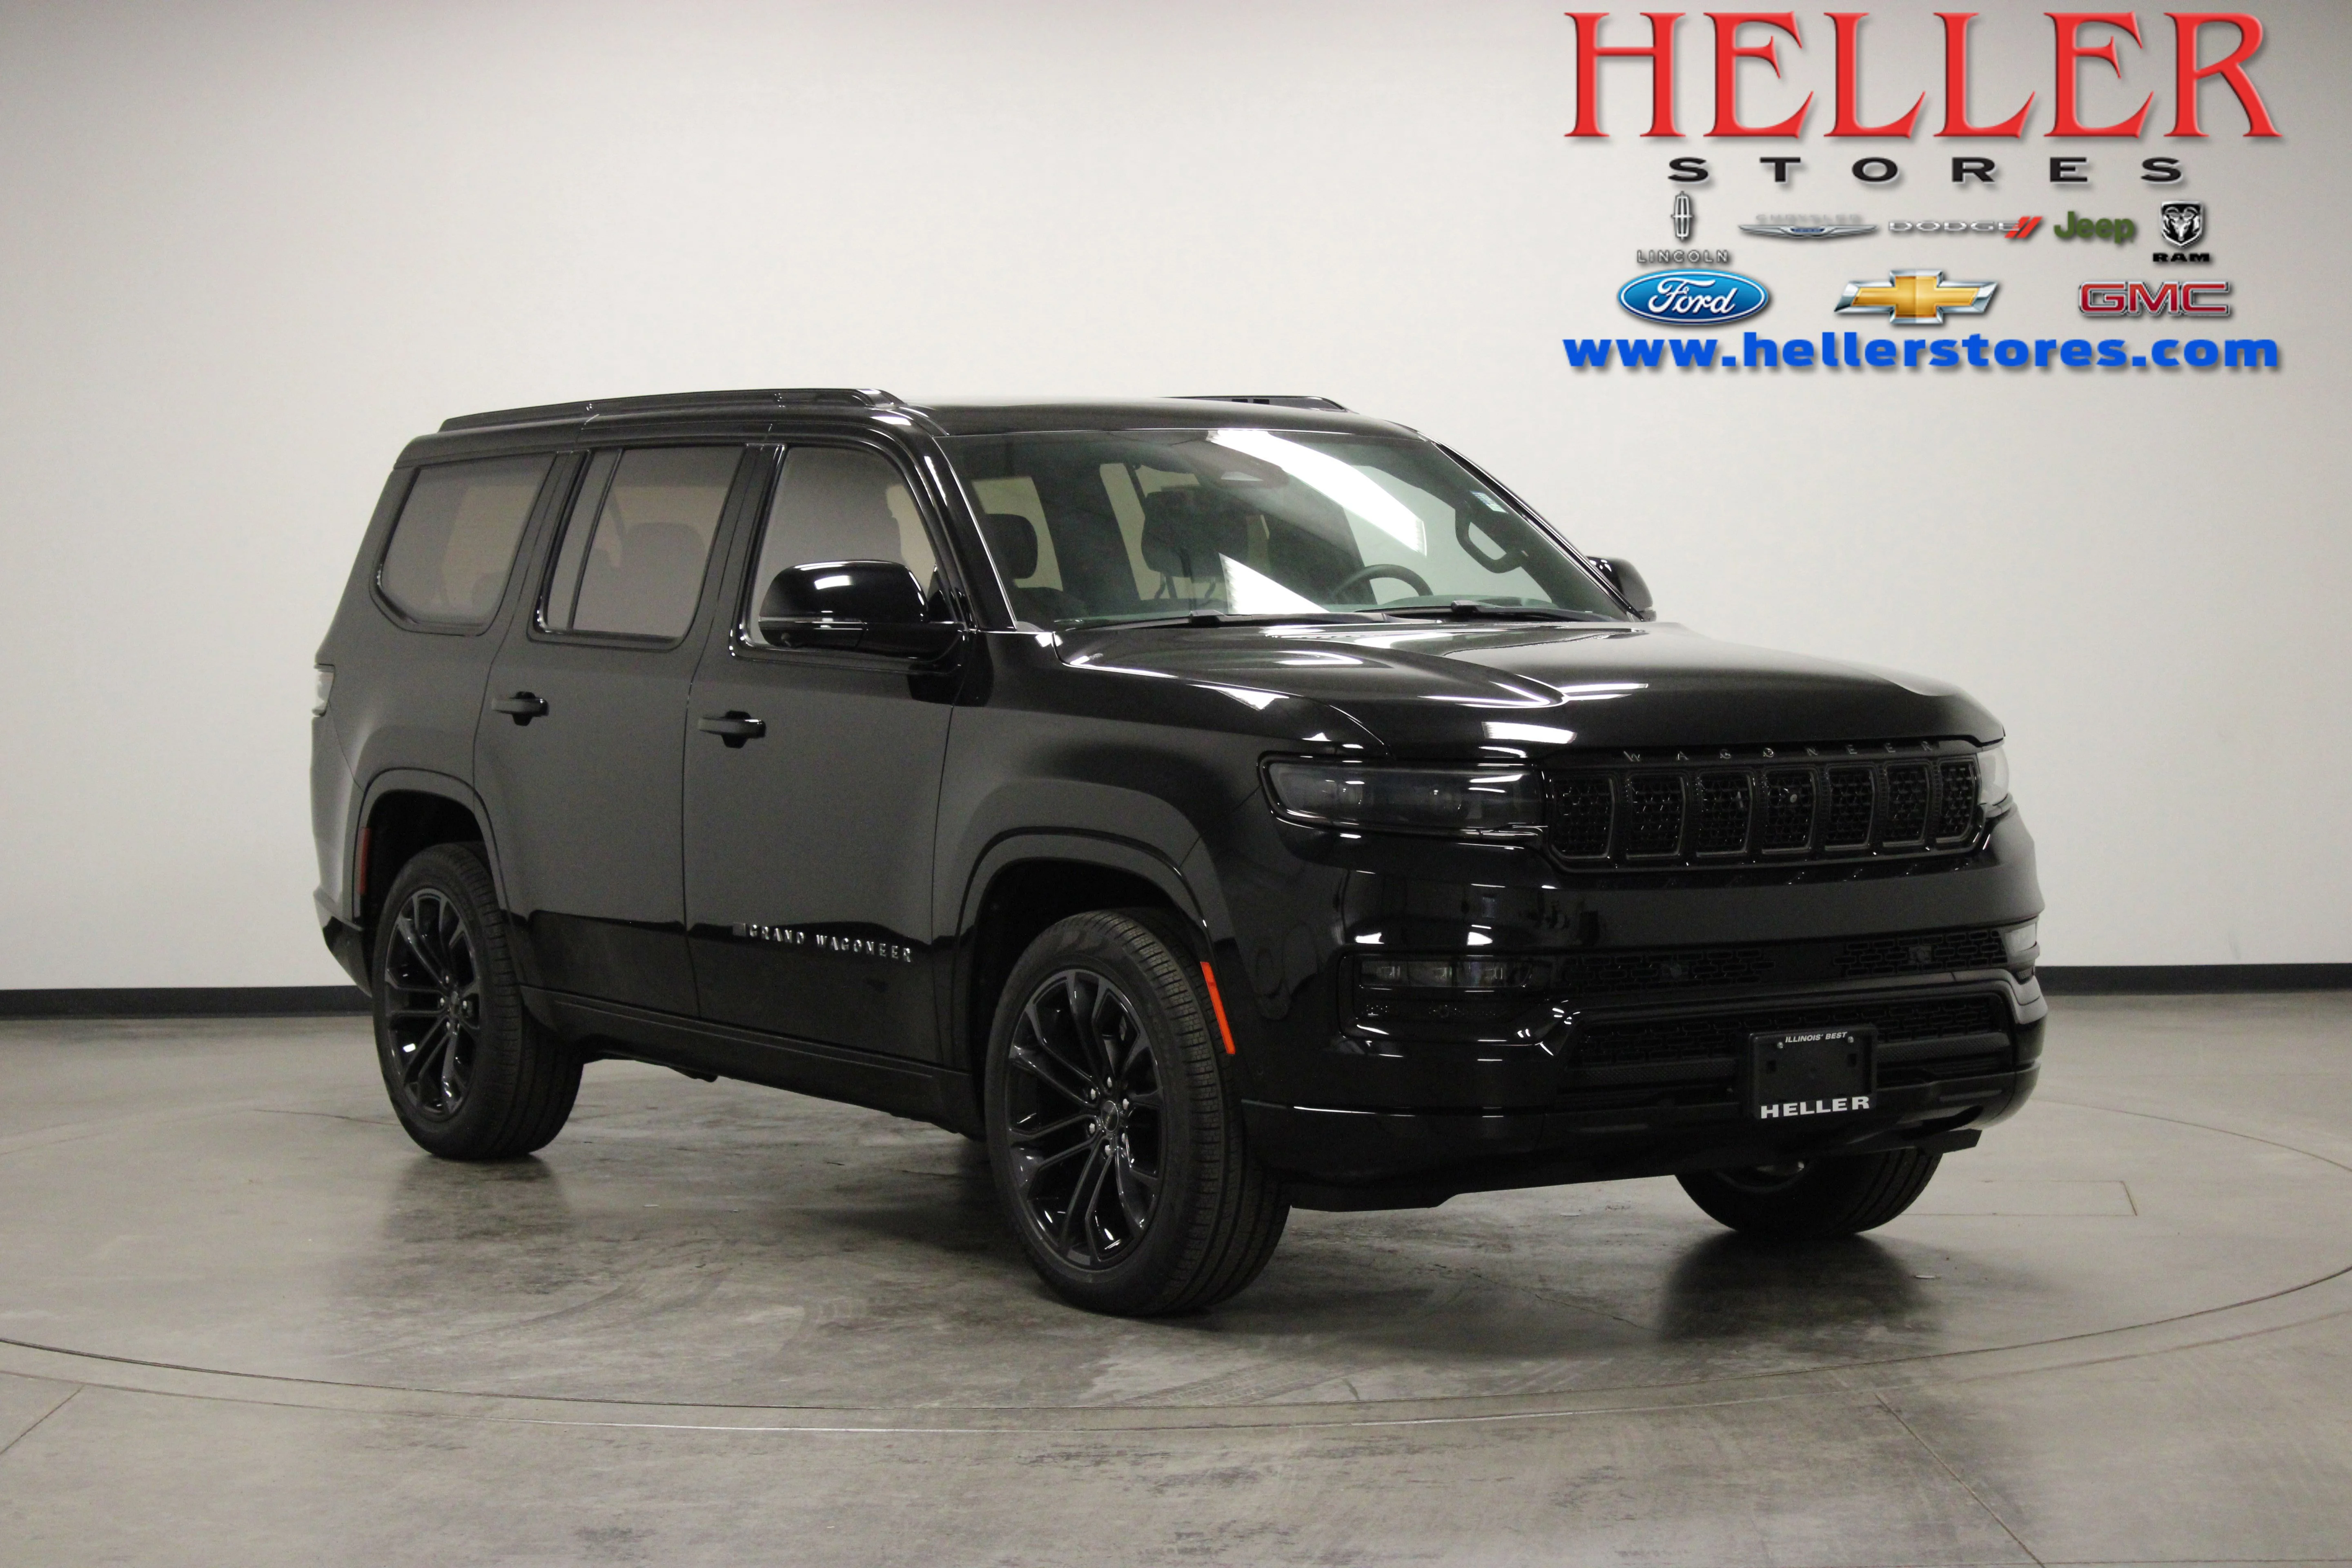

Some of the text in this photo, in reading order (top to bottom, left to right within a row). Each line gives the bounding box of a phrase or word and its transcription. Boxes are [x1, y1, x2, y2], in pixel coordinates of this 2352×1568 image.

[1623, 741, 1933, 762] WAGONEER
[749, 924, 912, 963] GRAND WAGONEER
[1825, 1031, 1848, 1040] BEST
[1761, 1096, 1870, 1119] HELLER
